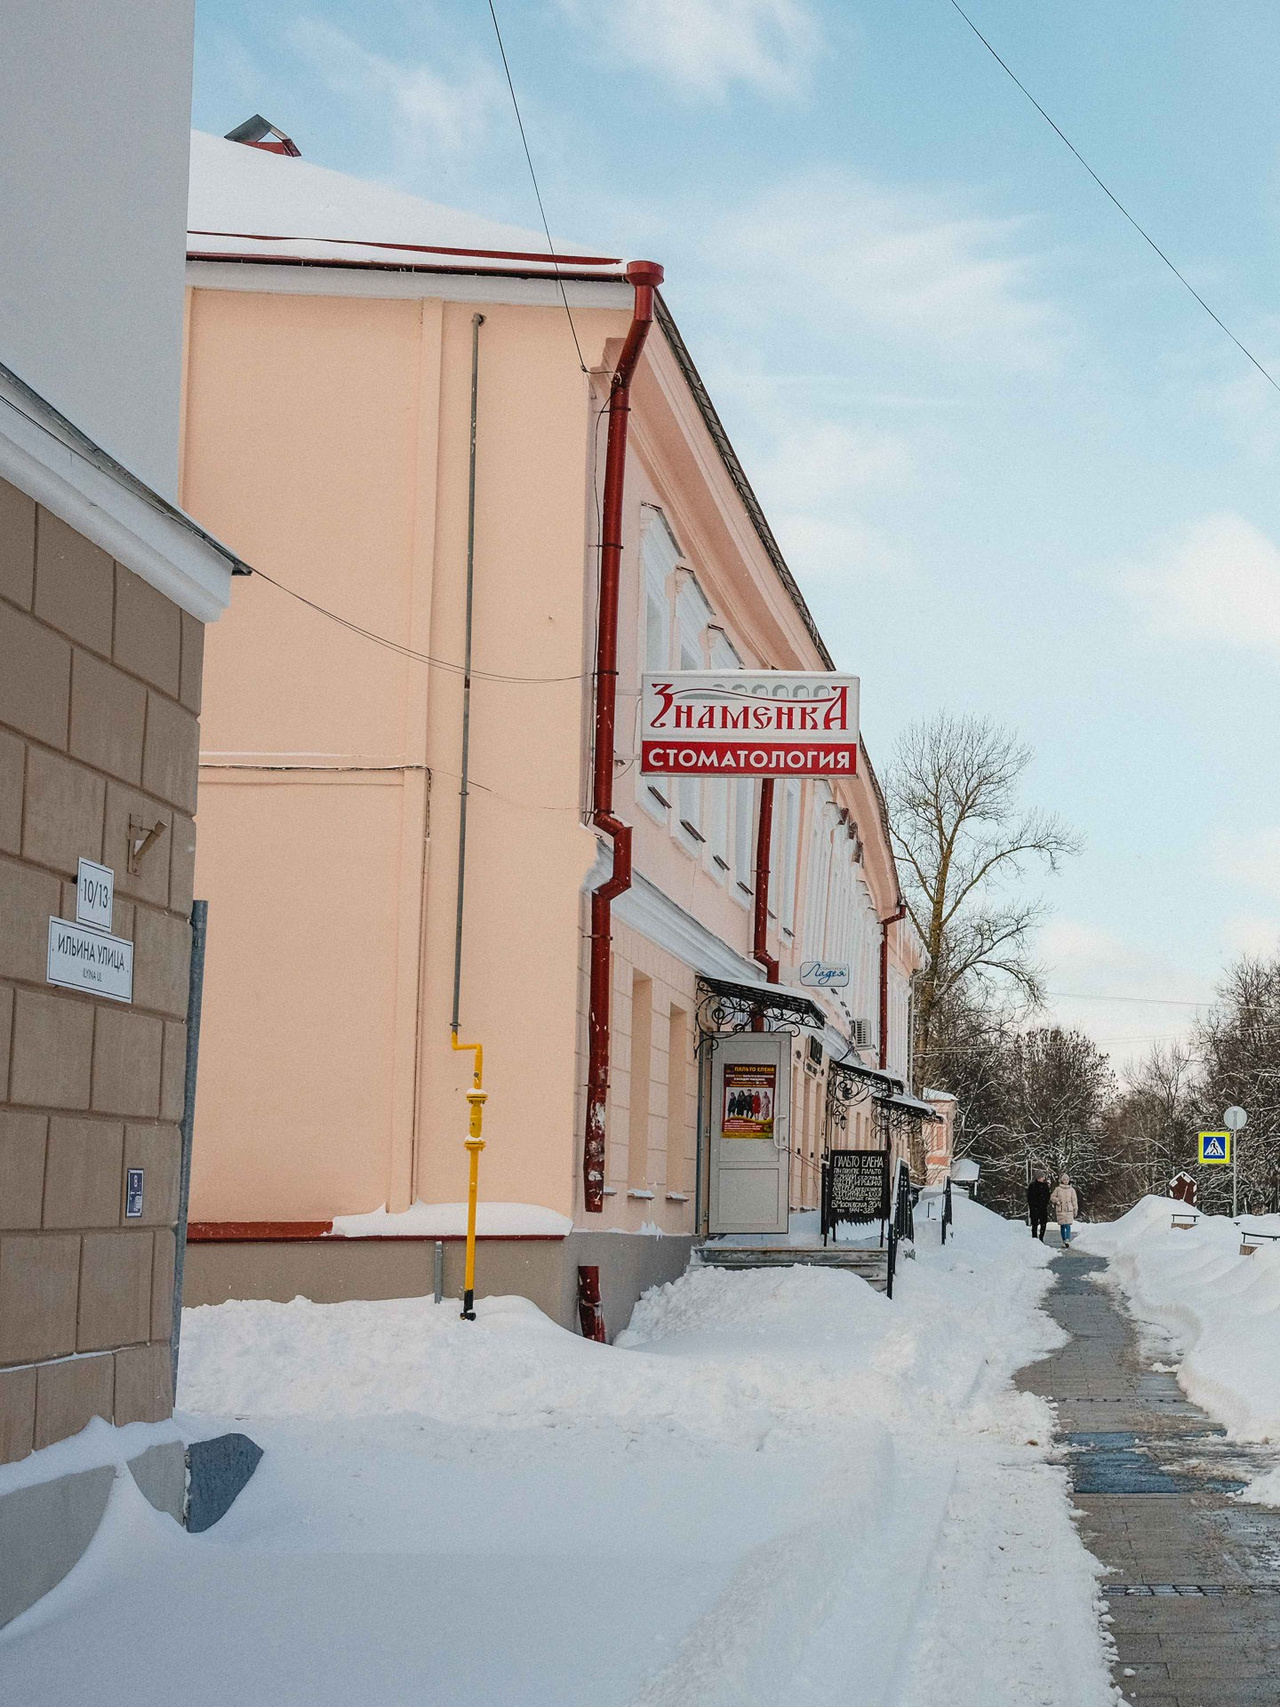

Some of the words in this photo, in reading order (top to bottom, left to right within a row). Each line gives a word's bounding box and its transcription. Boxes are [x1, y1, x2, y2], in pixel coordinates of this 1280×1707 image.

[648, 747, 850, 769] СТОМАТОЛОГИЯ
[83, 878, 109, 909] 10/13
[57, 933, 96, 963] ИЛЬИНА
[97, 945, 125, 972] УЛИЦА
[834, 1155, 860, 1168] ПАЛЬТО
[861, 1155, 884, 1168] ЕЛЕНА
